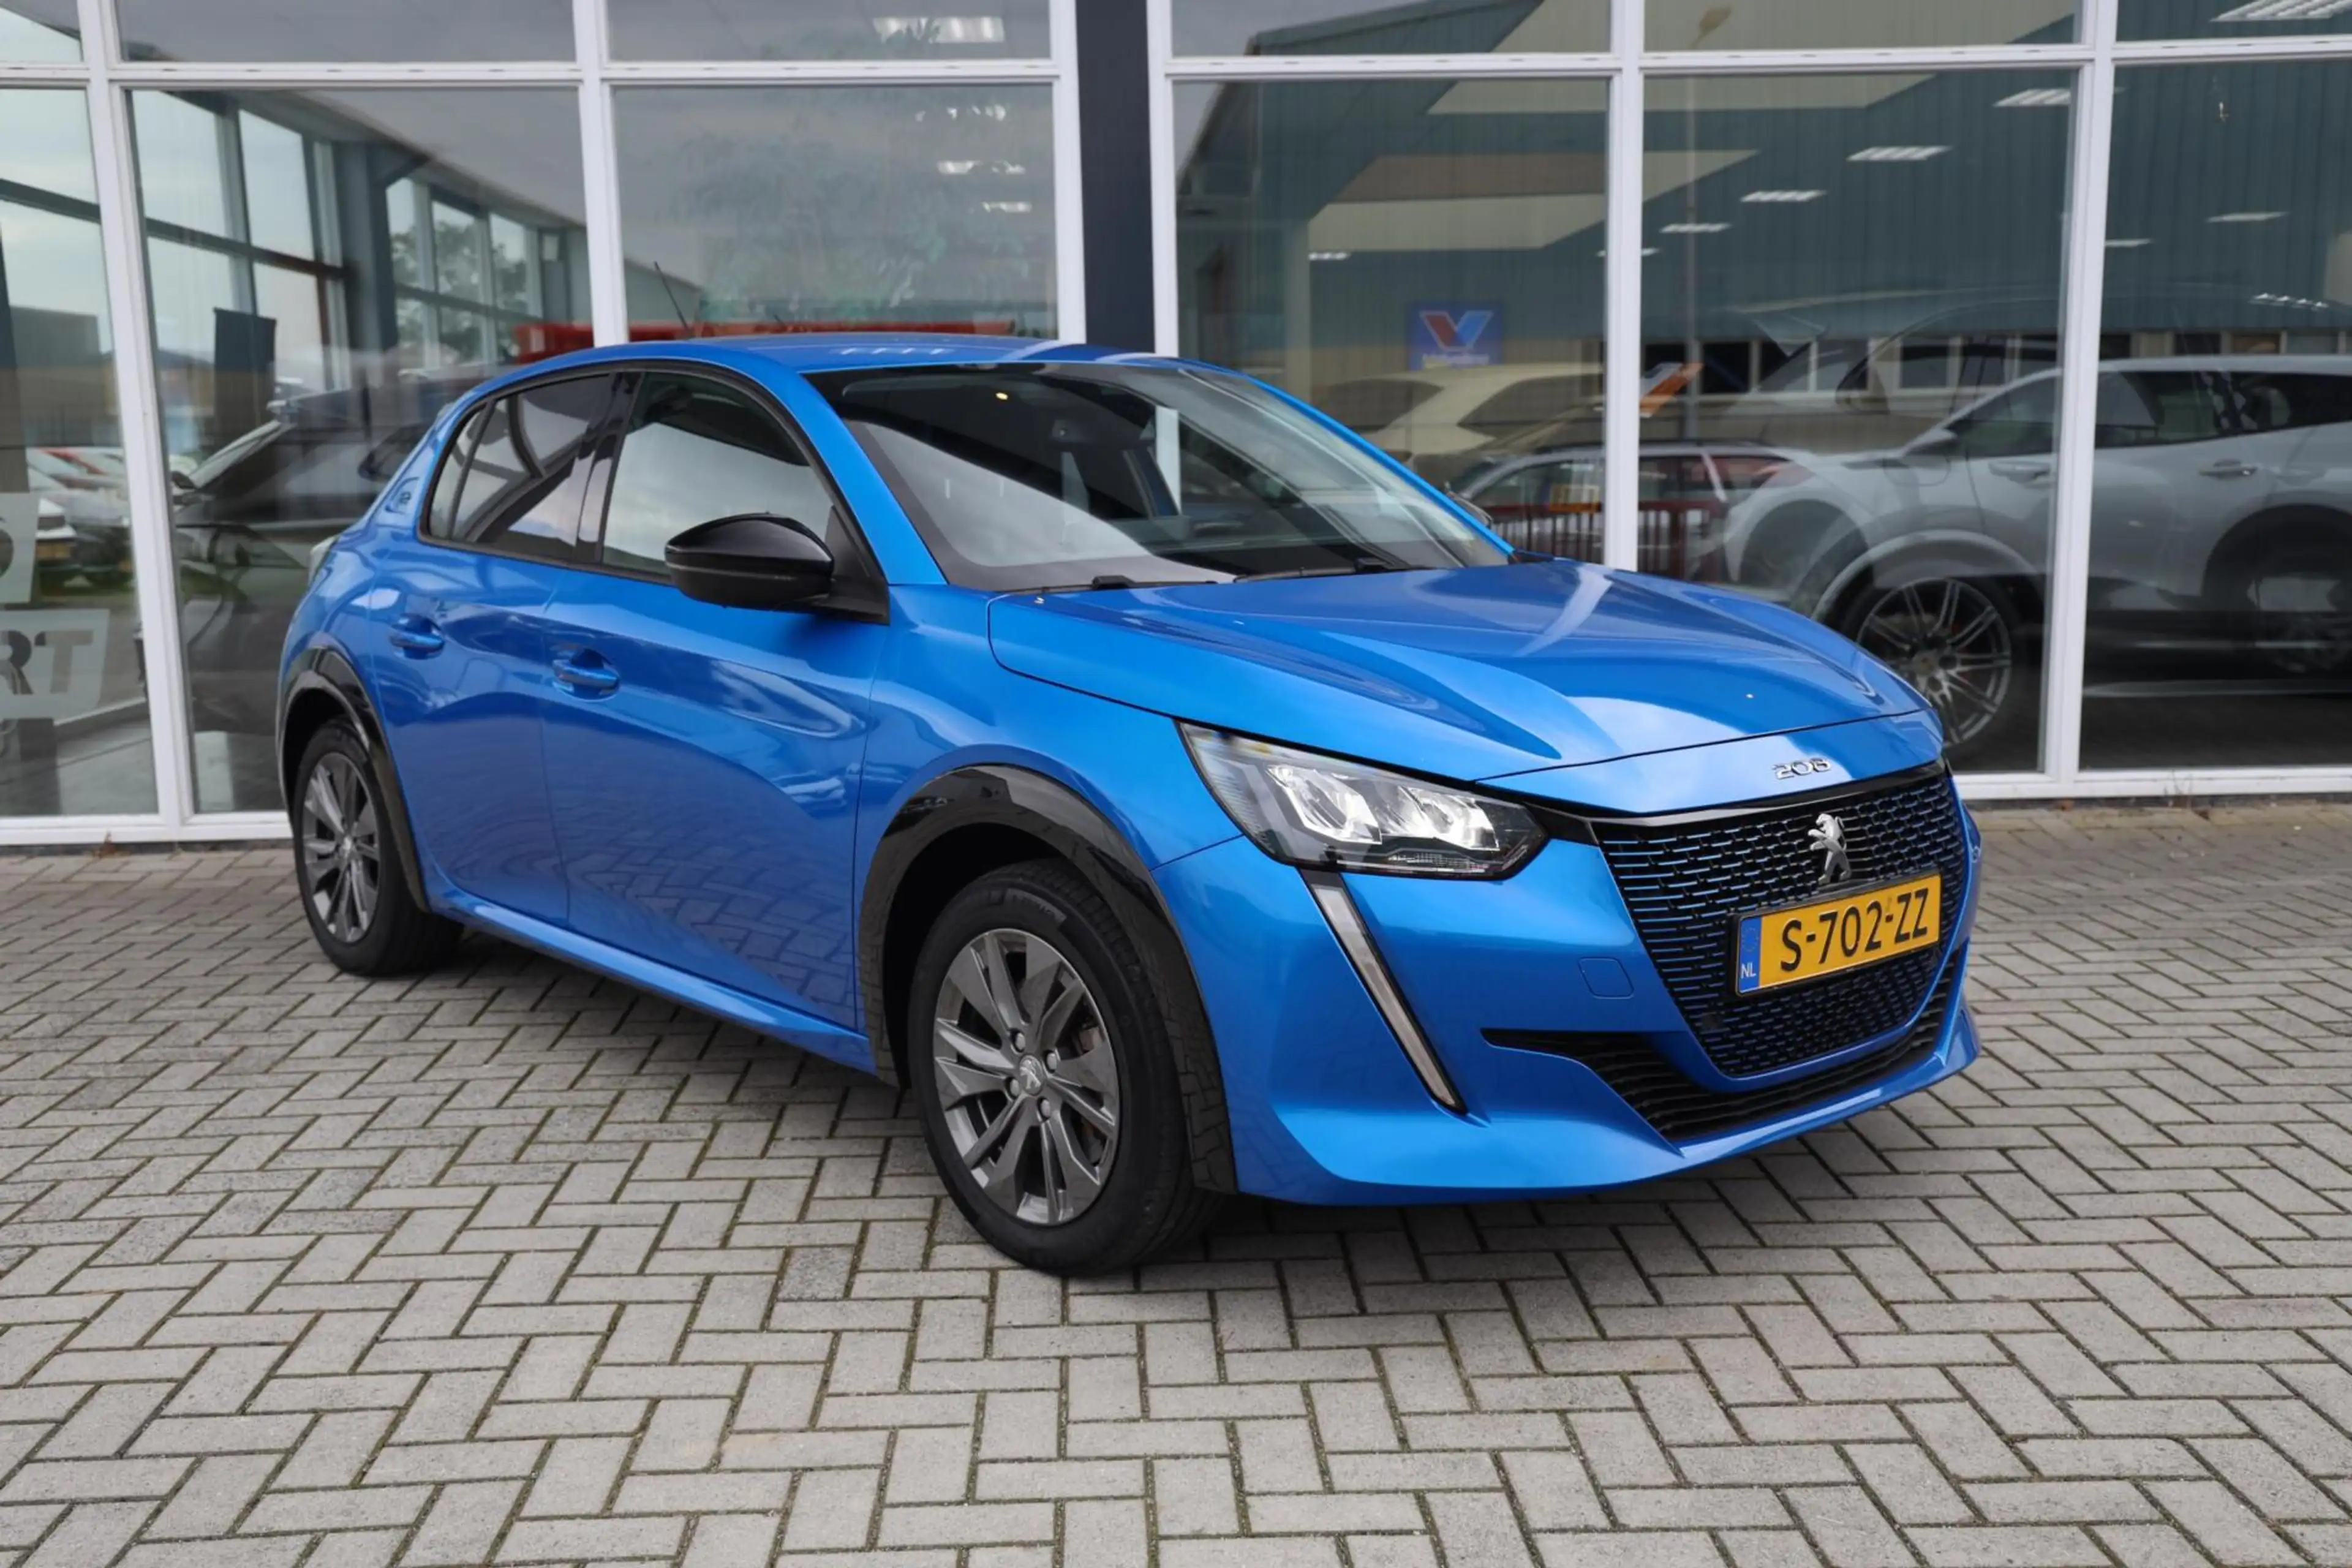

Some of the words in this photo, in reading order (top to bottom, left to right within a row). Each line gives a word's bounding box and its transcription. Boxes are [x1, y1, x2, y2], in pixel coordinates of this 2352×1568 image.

[1771, 758, 1830, 779] 208
[1780, 888, 1929, 971] S-702-ZZ
[1741, 962, 1756, 979] NL
